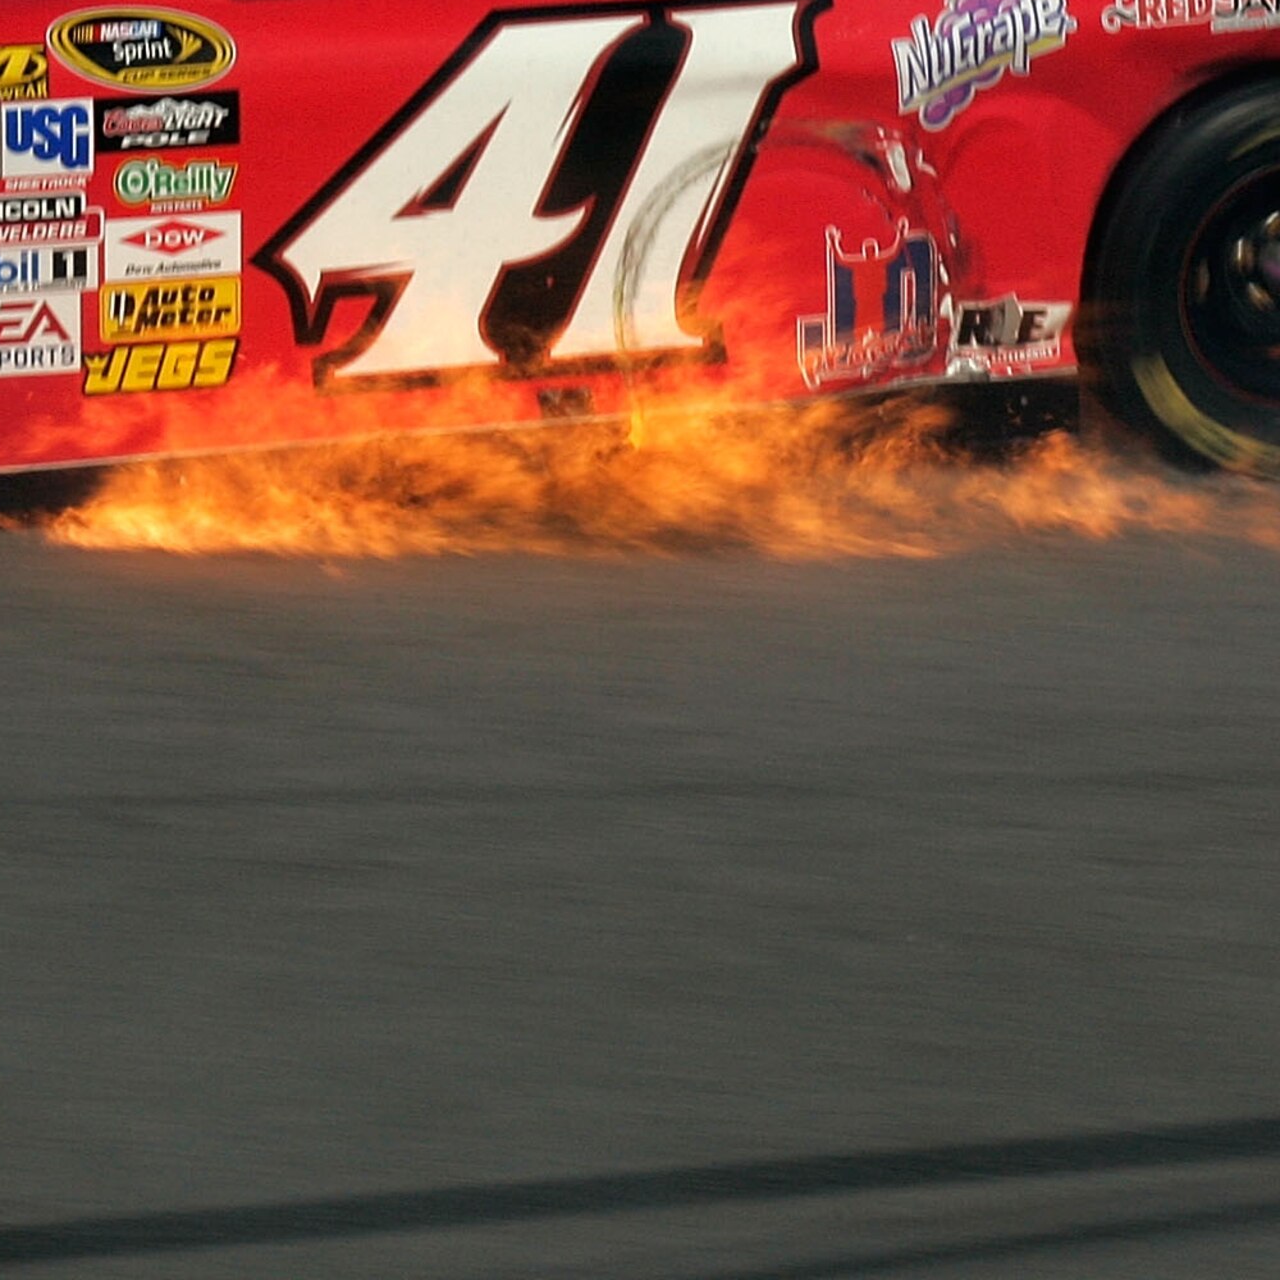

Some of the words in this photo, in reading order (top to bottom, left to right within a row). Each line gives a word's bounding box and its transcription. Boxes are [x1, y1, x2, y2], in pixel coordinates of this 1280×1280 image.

[101, 21, 163, 42] NASCAR
[113, 37, 172, 65] Sprint
[5, 105, 89, 169] USG
[121, 130, 210, 150] POLE
[118, 158, 233, 203] O'Reilly
[141, 285, 216, 308] Auto
[84, 338, 237, 396] JEGS
